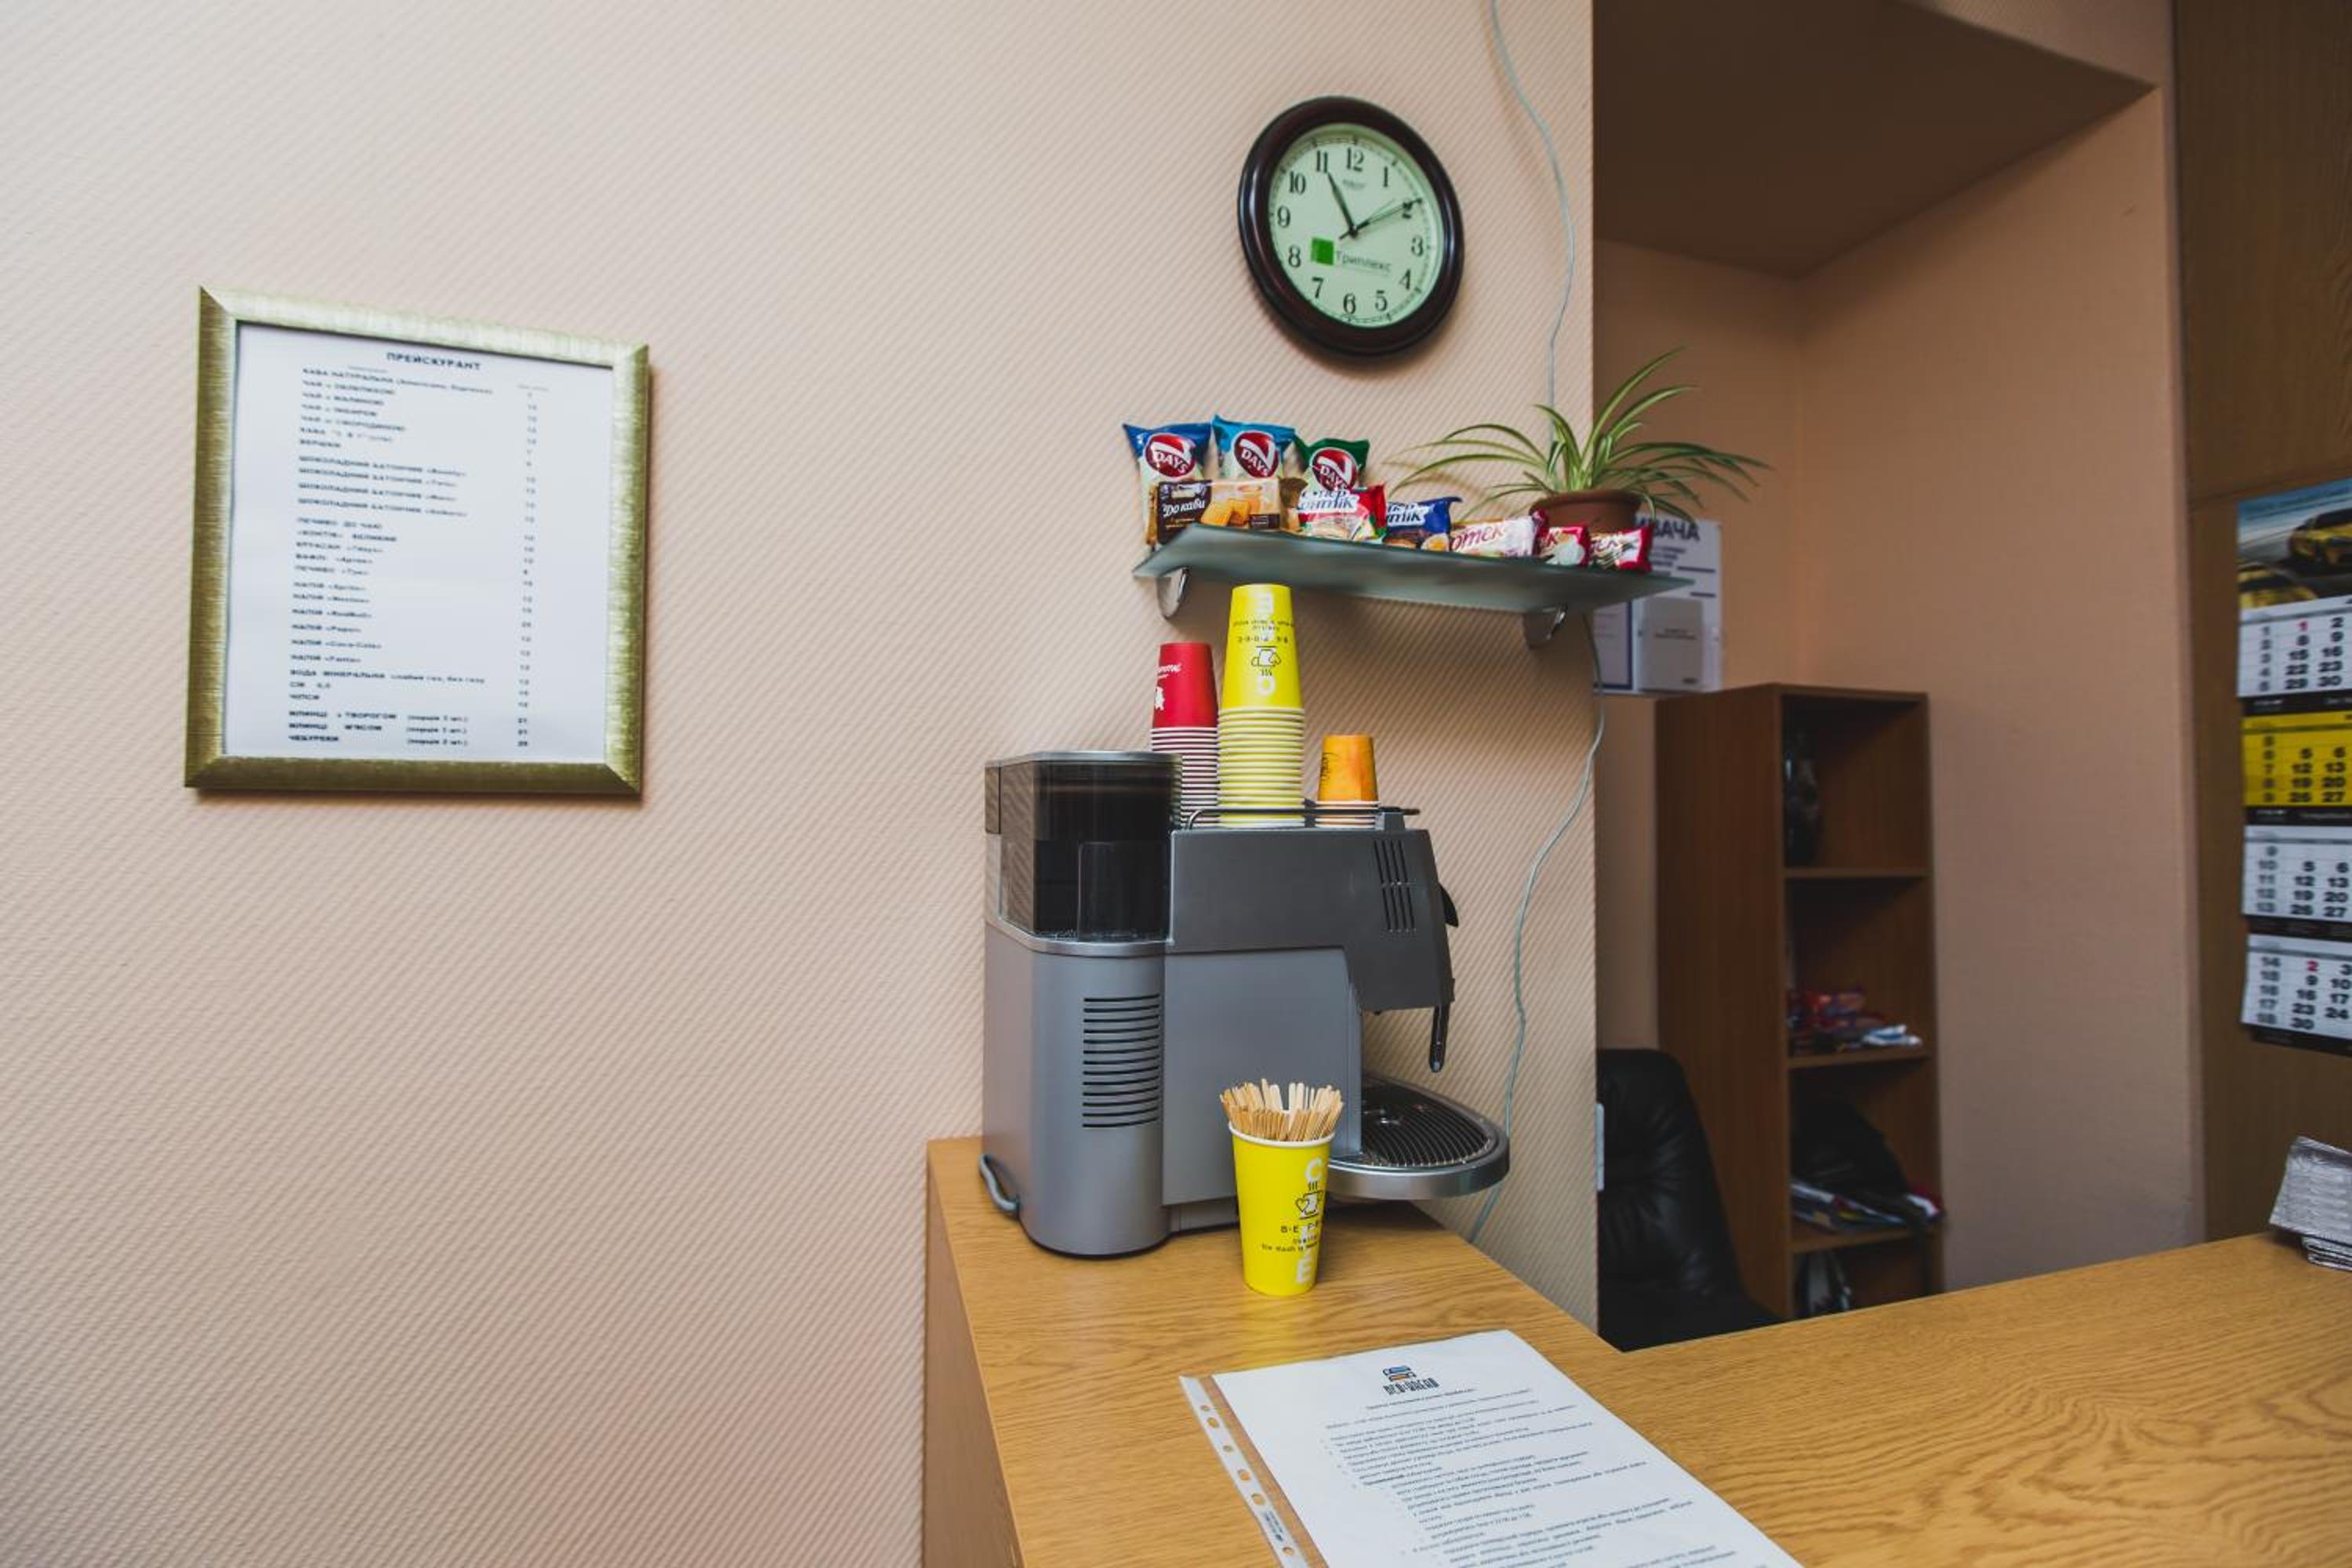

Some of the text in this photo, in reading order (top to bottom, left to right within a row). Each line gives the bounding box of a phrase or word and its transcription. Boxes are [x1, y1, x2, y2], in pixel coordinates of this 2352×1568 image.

[1316, 151, 1328, 173] 11
[1346, 147, 1364, 172] 12
[1289, 171, 1306, 194] 10
[1382, 166, 1389, 187] 1
[1277, 205, 1290, 228] 9
[1412, 237, 1424, 256] 3
[1288, 245, 1301, 267] 8
[1312, 277, 1323, 299] 7
[1399, 269, 1411, 290] 4
[1344, 292, 1356, 314] 6
[1375, 290, 1388, 311] 5
[387, 352, 481, 371] ПРЕЙСКУРАНТ
[1240, 437, 1275, 468] 7
[1155, 451, 1189, 473] DAYS
[1241, 449, 1269, 477] DAYS
[1317, 456, 1352, 484] 7
[2331, 617, 2344, 628] 2
[2331, 631, 2344, 643] 9
[2285, 664, 2309, 675] 22
[2318, 661, 2343, 673] 23
[2285, 678, 2308, 690] 29
[2318, 675, 2342, 687] 30
[2292, 763, 2313, 773] 12
[2325, 762, 2346, 772] 13
[2321, 777, 2347, 788] 20
[2321, 792, 2347, 803] 27
[2303, 861, 2315, 872] 5
[2336, 862, 2349, 873] 6
[2295, 876, 2315, 887] 12
[2328, 877, 2349, 887] 13
[2324, 891, 2348, 902] 20
[2323, 906, 2347, 917] 27
[2307, 960, 2319, 972] 2
[2340, 964, 2352, 975] 3
[2307, 975, 2318, 985] 9
[2330, 978, 2351, 989] 10
[2296, 989, 2317, 1000] 16
[2330, 993, 2350, 1004] 17
[2292, 1003, 2315, 1015] 23
[2325, 1007, 2350, 1019] 24
[2290, 1017, 2314, 1029] 30
